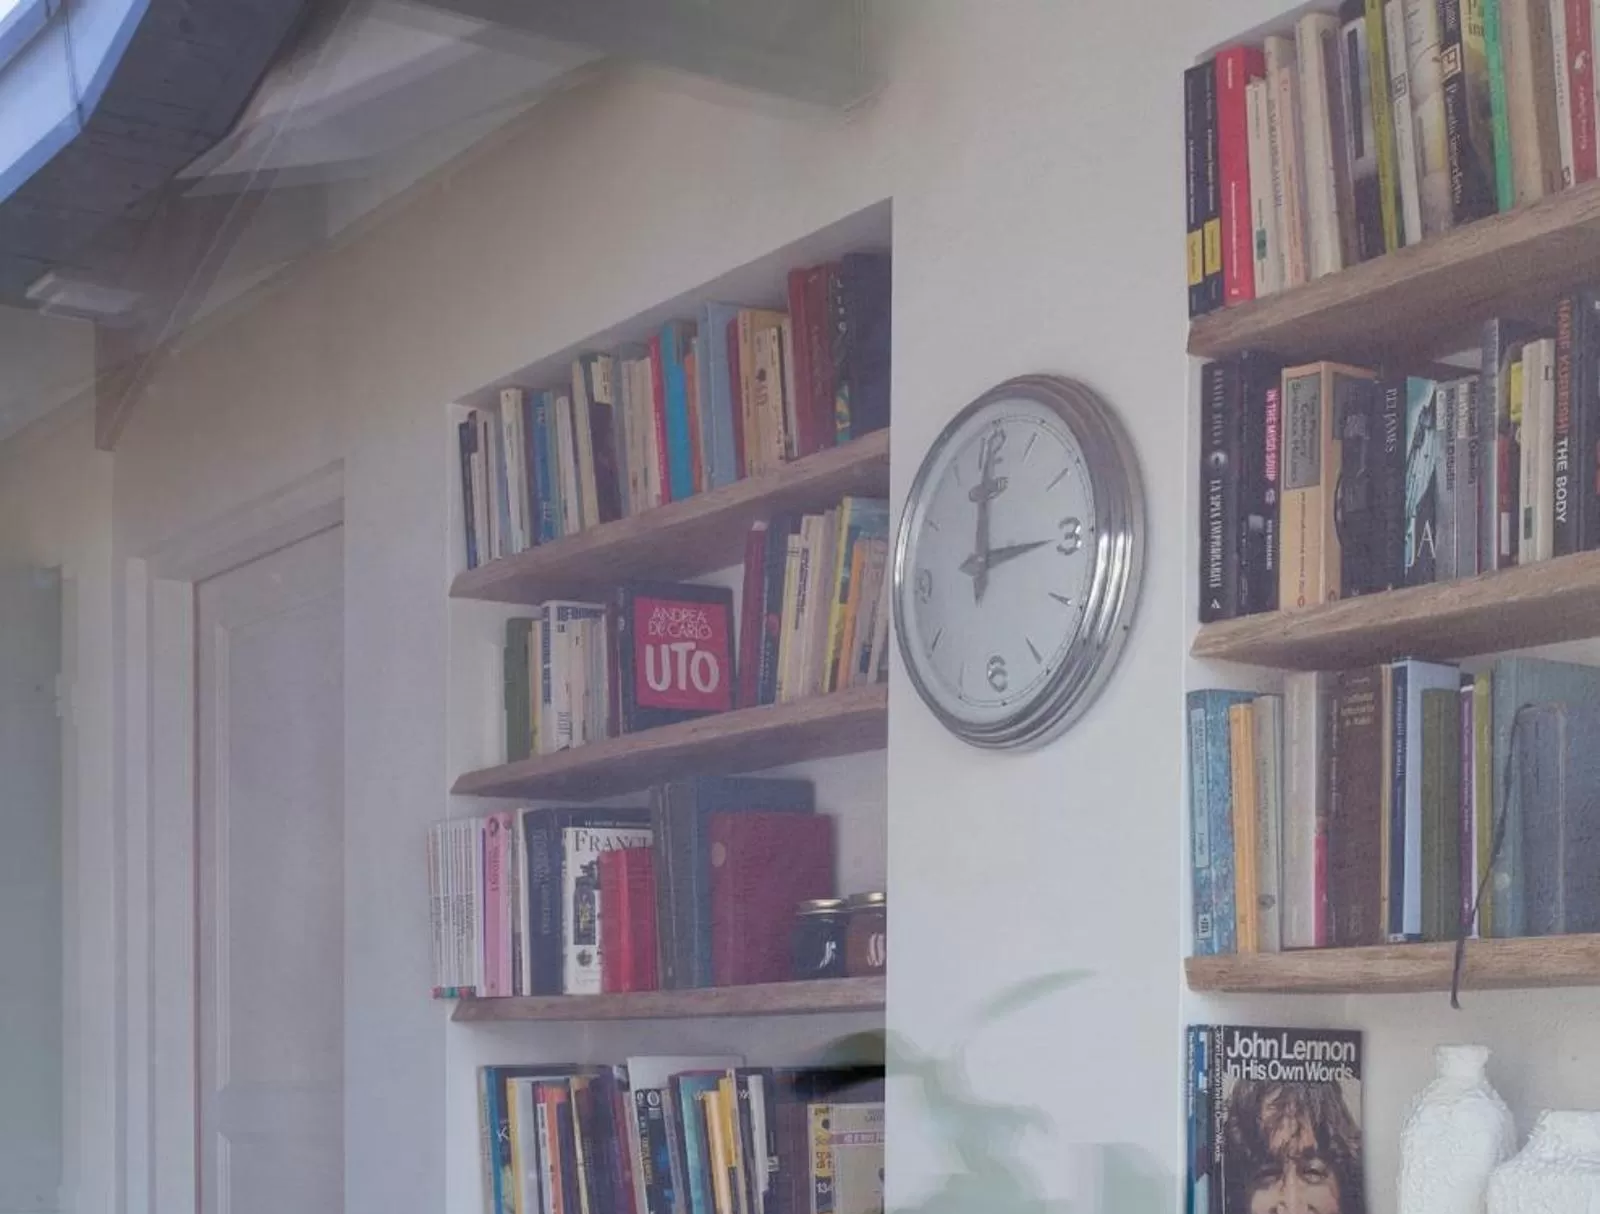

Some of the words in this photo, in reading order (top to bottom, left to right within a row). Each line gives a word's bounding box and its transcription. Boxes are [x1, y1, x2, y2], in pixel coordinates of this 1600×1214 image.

[1555, 437, 1569, 471] THE
[1554, 475, 1568, 523] BODY
[1056, 517, 1082, 555] 3
[652, 607, 708, 624] ANDREA
[667, 621, 713, 640] CARLO
[645, 641, 720, 693] UTO
[986, 654, 1008, 693] 6
[1227, 1031, 1279, 1058] John
[1281, 1032, 1356, 1062] Lennon
[1226, 1059, 1240, 1077] In
[1242, 1060, 1266, 1080] His
[1268, 1060, 1304, 1081] Own
